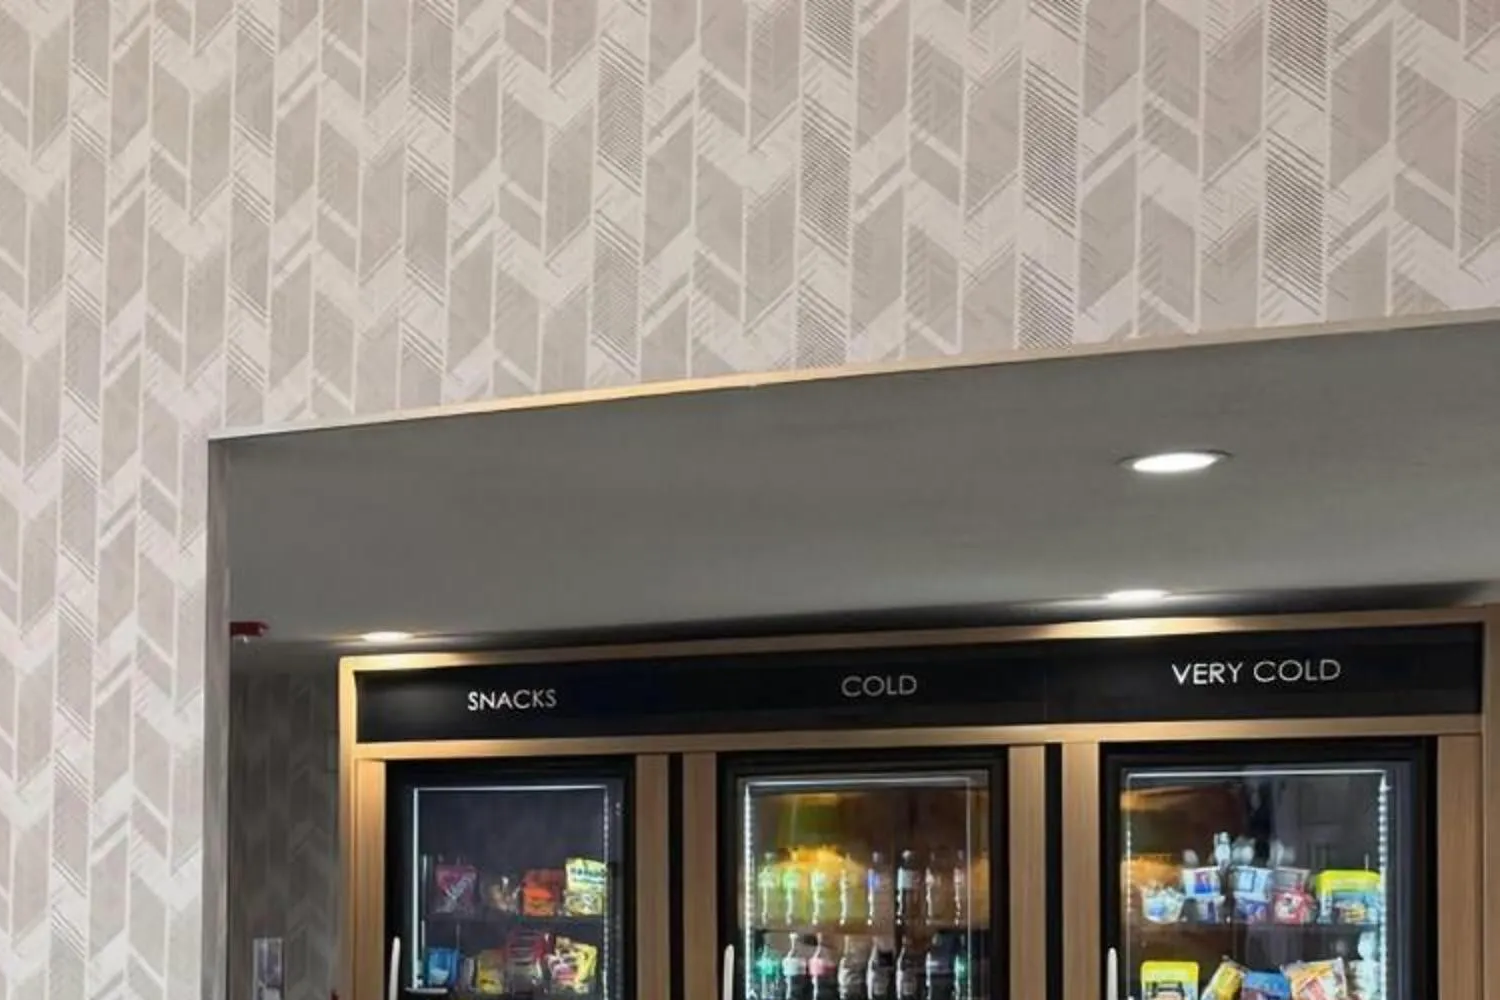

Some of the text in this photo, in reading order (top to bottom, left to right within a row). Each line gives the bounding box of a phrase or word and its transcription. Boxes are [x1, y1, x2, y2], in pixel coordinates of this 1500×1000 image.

[1171, 659, 1341, 684] VERY COLD
[841, 675, 917, 697] COLD
[467, 689, 557, 711] SNACKS
